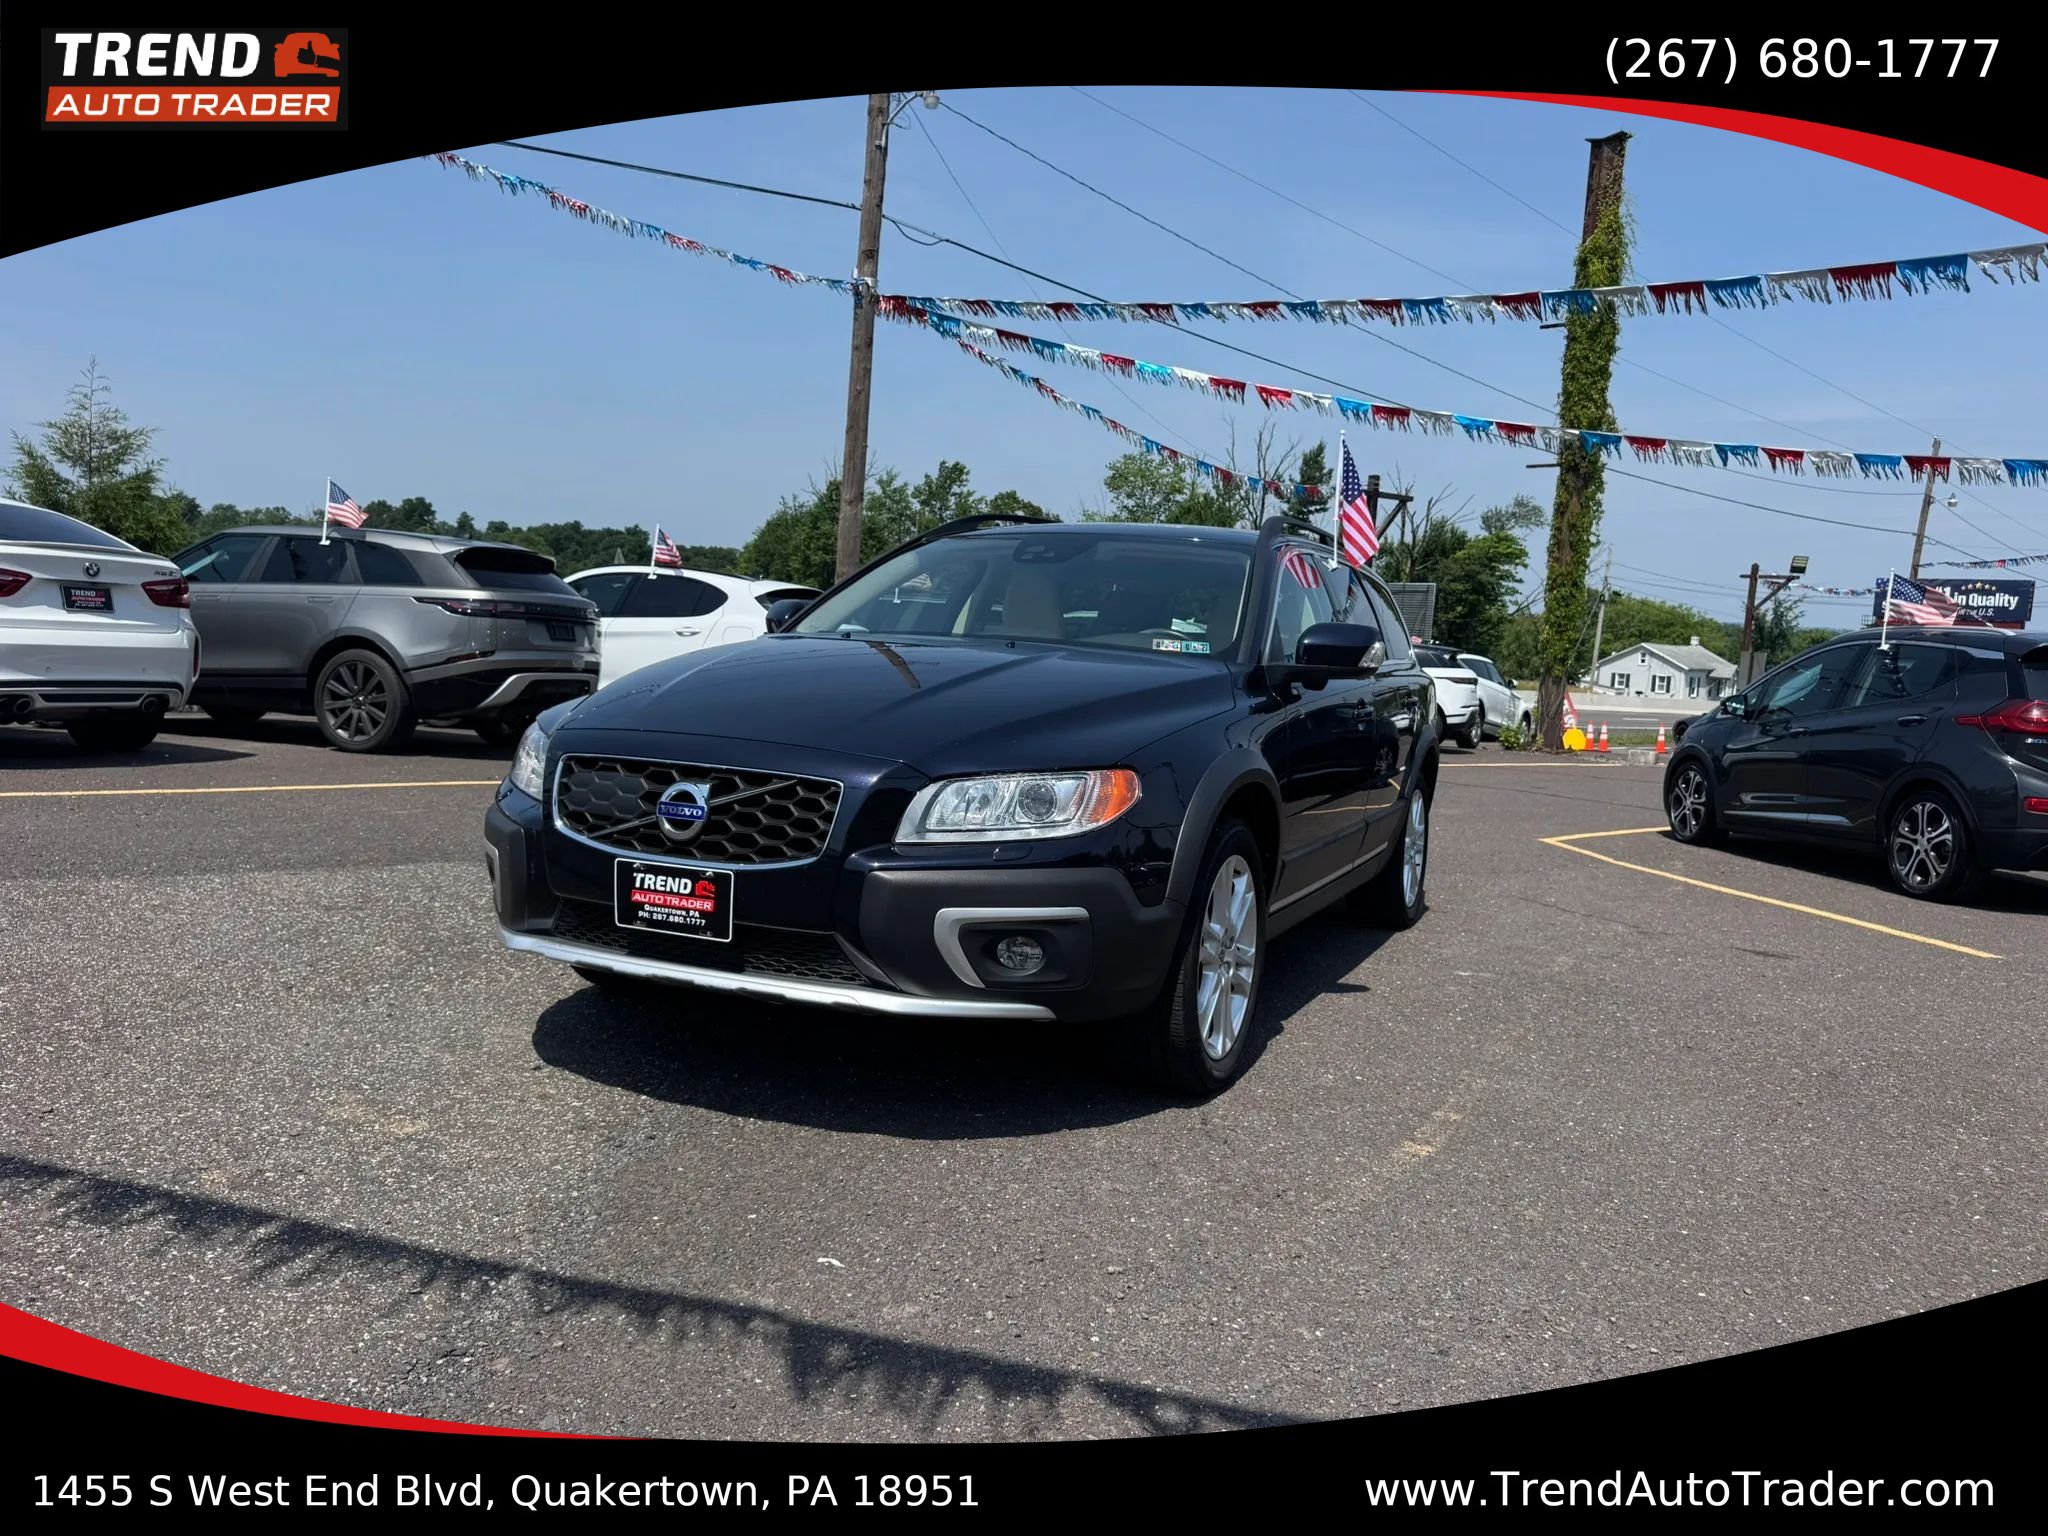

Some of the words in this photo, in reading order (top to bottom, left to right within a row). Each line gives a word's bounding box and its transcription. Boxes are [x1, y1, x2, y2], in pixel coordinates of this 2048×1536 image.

[1968, 593, 2019, 610] Quality
[1978, 608, 1995, 616] U.S.
[660, 804, 703, 817] VOLVO
[633, 872, 692, 895] TREND
[633, 892, 663, 904] AUTO
[664, 896, 712, 910] TRADER
[638, 910, 651, 919] PH:
[652, 912, 706, 926] 267.680.1777
[689, 910, 700, 918] PA
